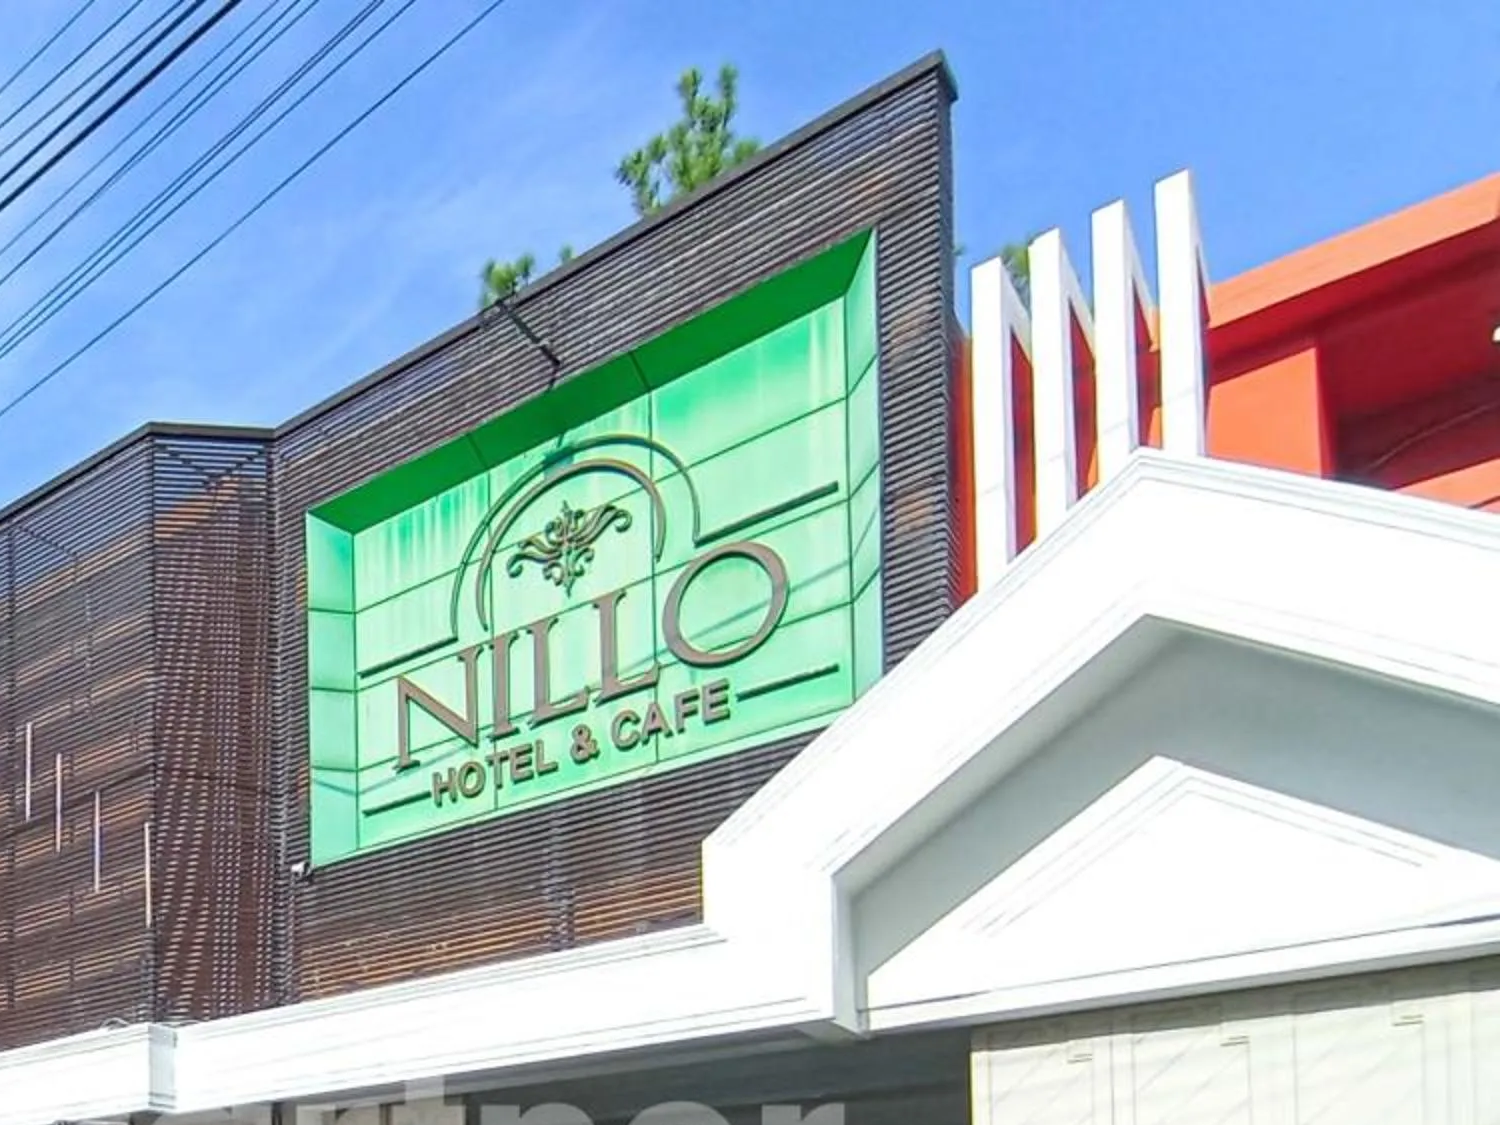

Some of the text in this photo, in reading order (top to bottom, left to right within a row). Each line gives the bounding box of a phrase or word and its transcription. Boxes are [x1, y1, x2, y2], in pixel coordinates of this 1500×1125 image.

[393, 540, 789, 772] NILLO
[431, 676, 732, 807] HOTEL & CAFE
